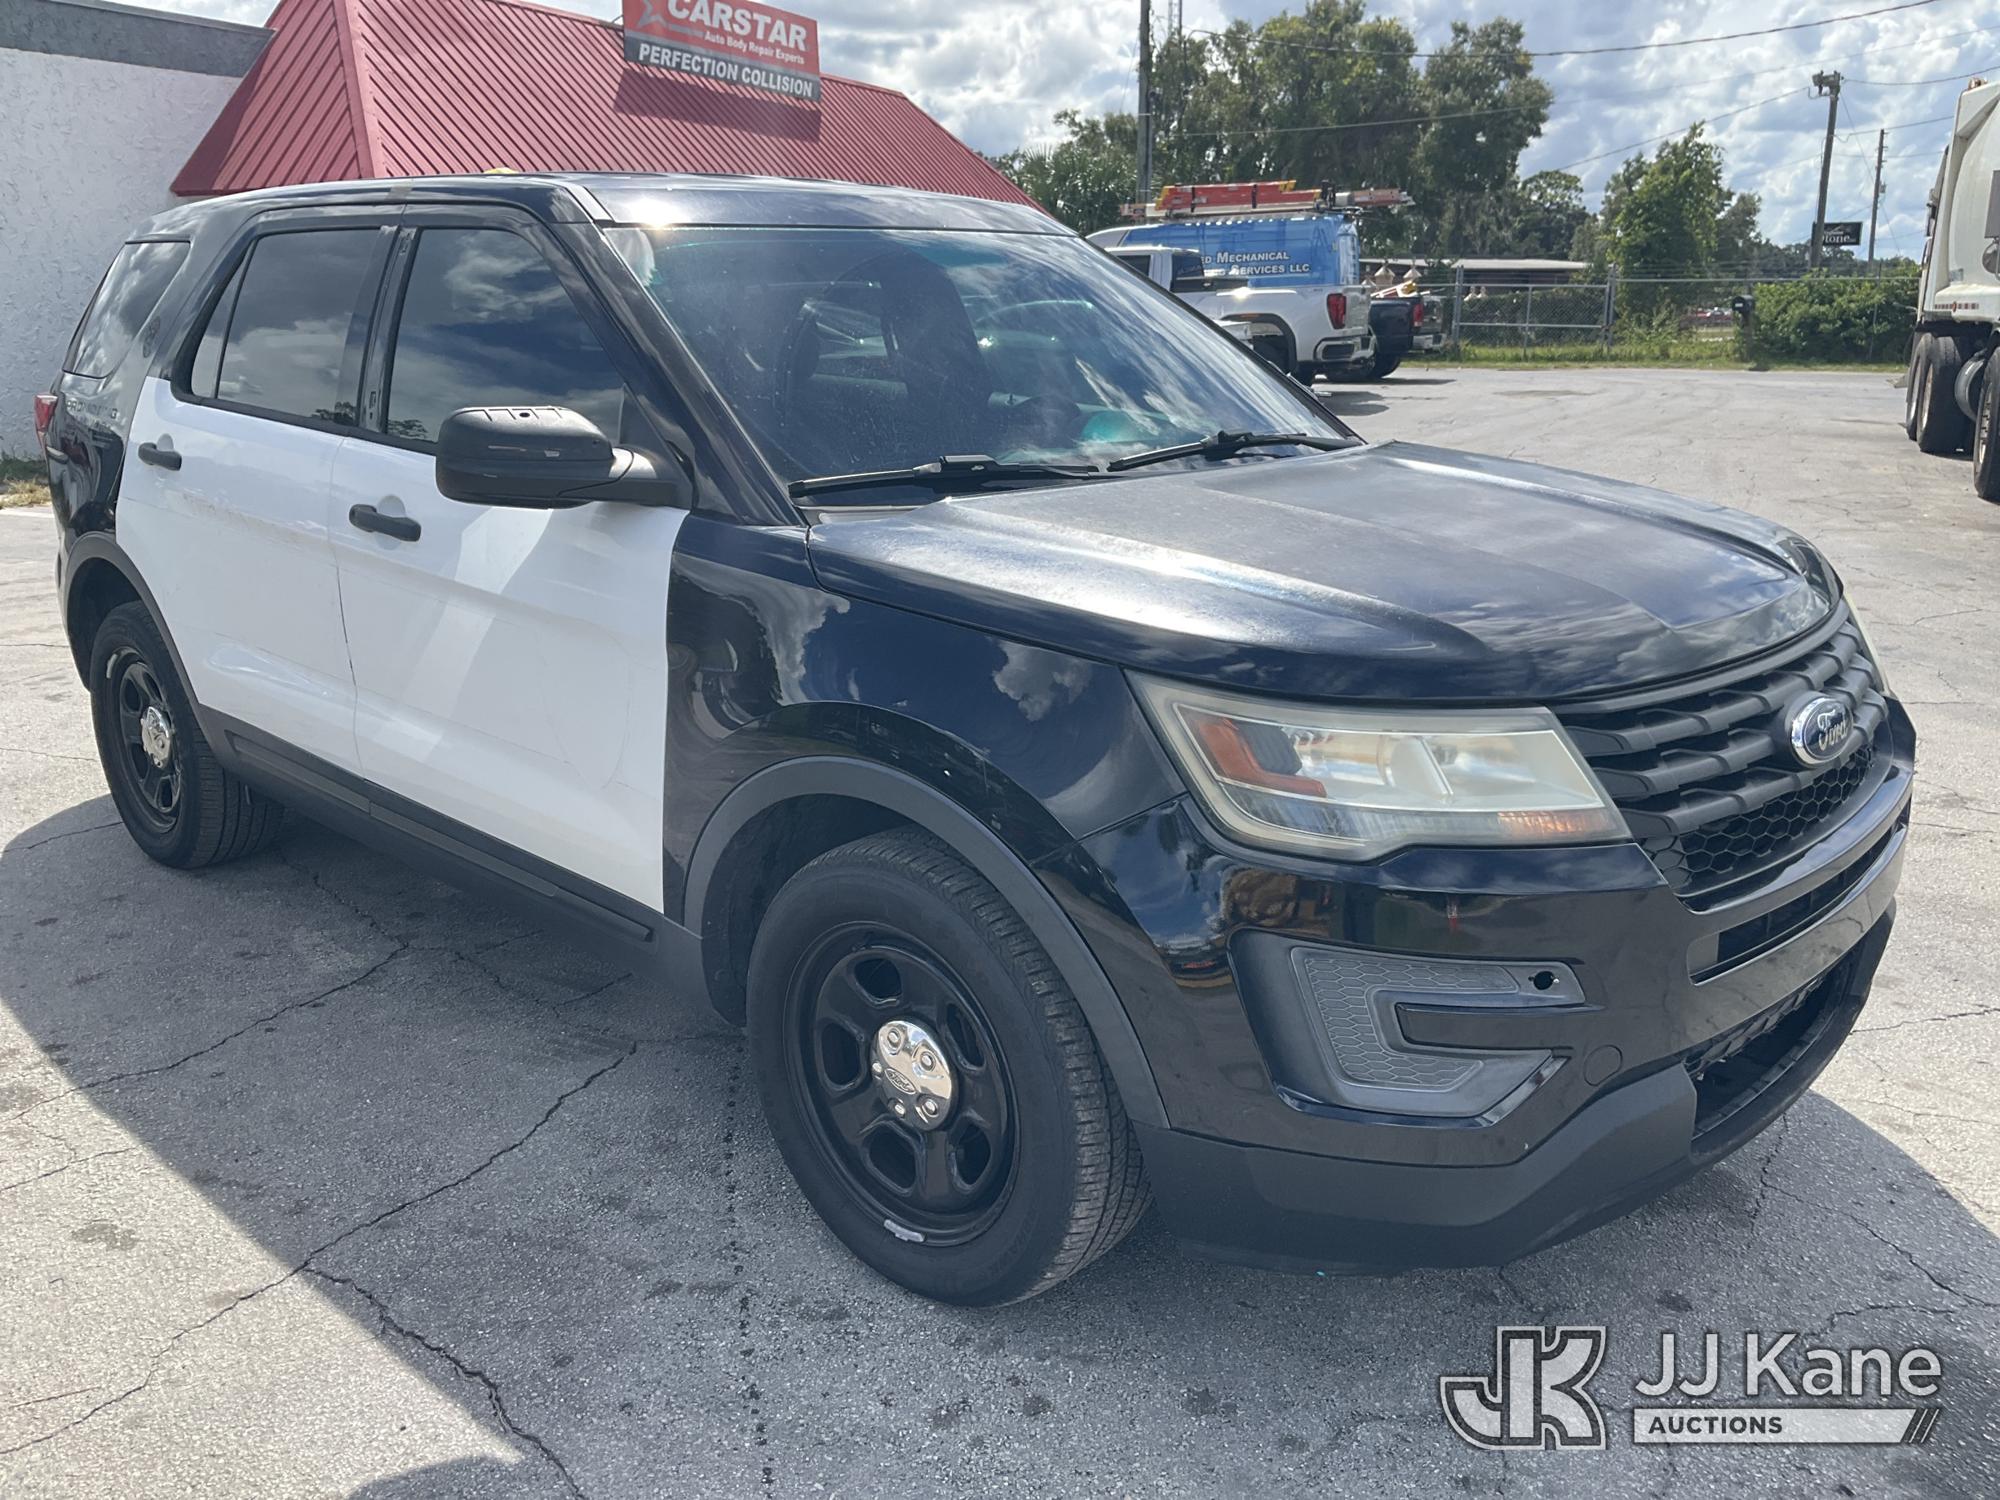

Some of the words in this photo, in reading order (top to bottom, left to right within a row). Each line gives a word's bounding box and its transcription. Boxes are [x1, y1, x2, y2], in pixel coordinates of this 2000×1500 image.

[668, 0, 808, 52] CARSTAR
[704, 31, 725, 45] Auto
[727, 37, 747, 52] Body
[749, 42, 774, 58] Repair
[776, 49, 805, 65] Experts
[638, 43, 738, 81] PERFECTION
[741, 67, 813, 98] COLLISION
[1216, 251, 1290, 263] MECHANICAL
[1229, 264, 1285, 275] SERVICES
[1289, 263, 1310, 273] LLC
[1817, 709, 1849, 751] Ford
[888, 1071, 913, 1091] Ford
